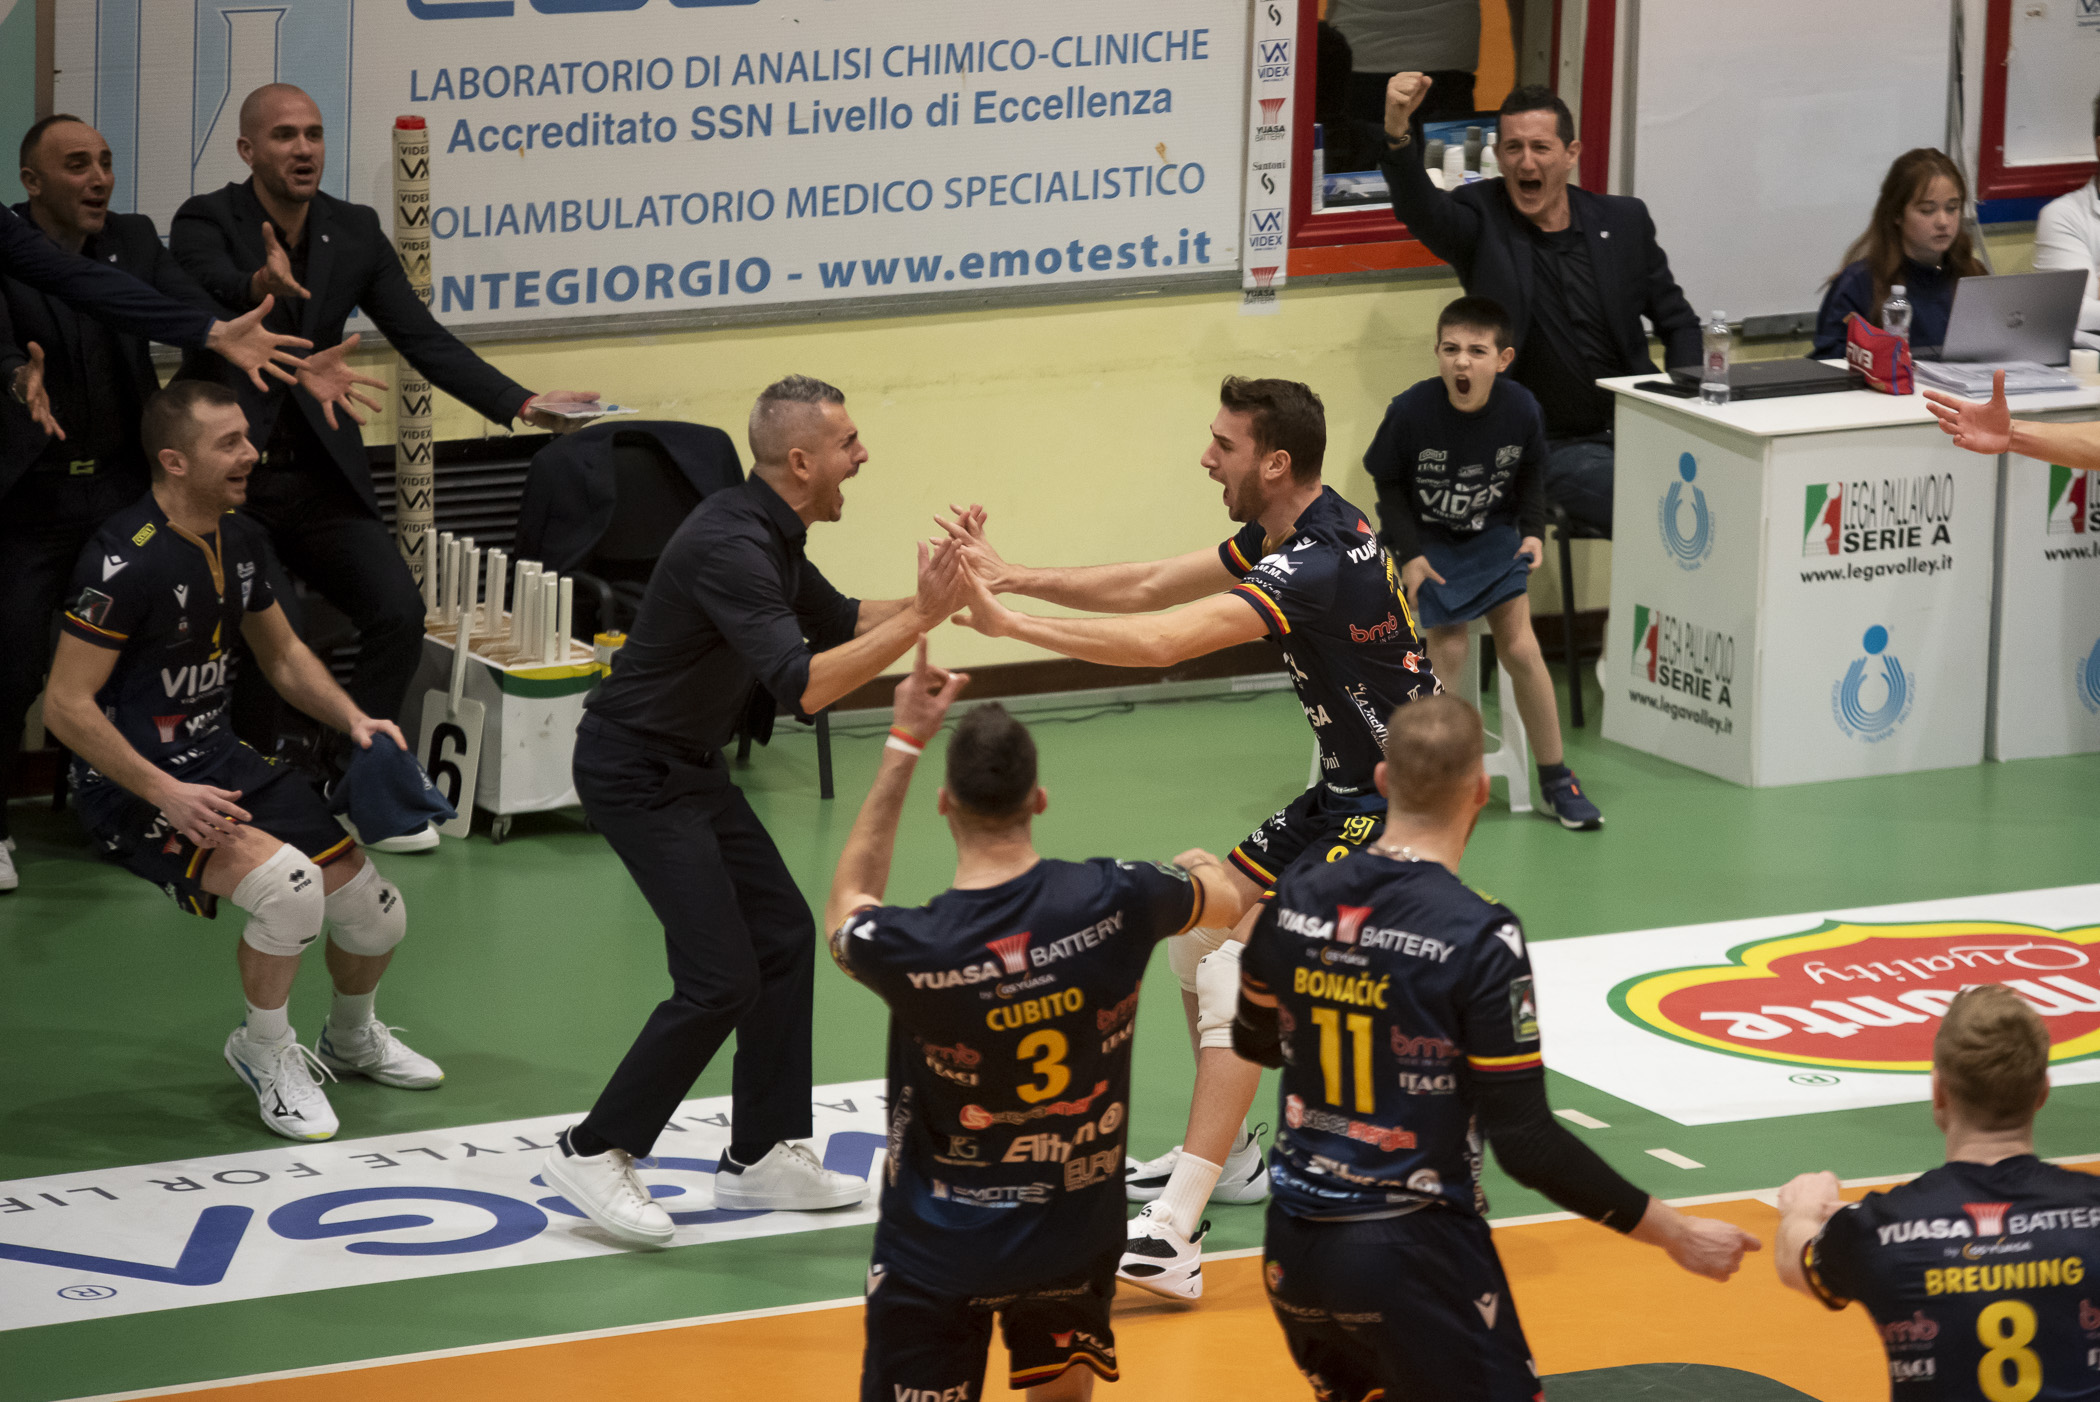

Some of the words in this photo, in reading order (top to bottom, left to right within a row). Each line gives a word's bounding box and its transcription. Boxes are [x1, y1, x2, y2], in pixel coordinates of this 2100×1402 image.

[411, 57, 673, 102] LABORATORIO
[685, 55, 720, 89] DI
[732, 47, 871, 87] ANALISI
[882, 28, 1209, 78] CHIMICO-CLINICHE
[1257, 66, 1289, 78] VIDEX
[447, 111, 677, 153] Accreditato
[691, 103, 772, 141] SSN
[787, 97, 913, 135] Livello
[926, 93, 959, 127] di
[974, 85, 1172, 124] Eccellenza
[1256, 125, 1286, 134] YUASA
[1252, 160, 1286, 171] Santoni
[431, 189, 775, 240] OLIAMBULATORIO
[786, 180, 932, 218] MEDICO
[944, 162, 1205, 209] SPECIALISTICO
[819, 228, 1211, 288] www.emotest.it
[1249, 235, 1282, 247] VIDEX
[1418, 481, 1505, 515] VIDEX
[1844, 480, 1877, 530] LEGA
[1843, 526, 1921, 553] SERIE
[1931, 524, 1951, 546] A
[1800, 554, 1953, 583] www.legavolley.it
[1658, 664, 1712, 702] SERIE
[1718, 685, 1731, 709] A
[426, 722, 467, 812] 6
[906, 961, 1003, 990] YUASA
[1029, 910, 1124, 968] BATTERY
[1360, 926, 1456, 964] BATTERY
[1803, 942, 2090, 985] Quality
[985, 986, 1085, 1031] CUBITO
[1294, 966, 1391, 1010] BONAČIĆ
[1015, 1028, 1071, 1104] 3
[1311, 1006, 1375, 1115] 11
[1399, 1071, 1457, 1091] ITACI
[347, 1131, 562, 1169] TYLE
[147, 1162, 322, 1192] FOR
[1877, 1218, 1974, 1246] YUASA
[1924, 1256, 2086, 1297] BREUNING
[1976, 1299, 2044, 1402] 8
